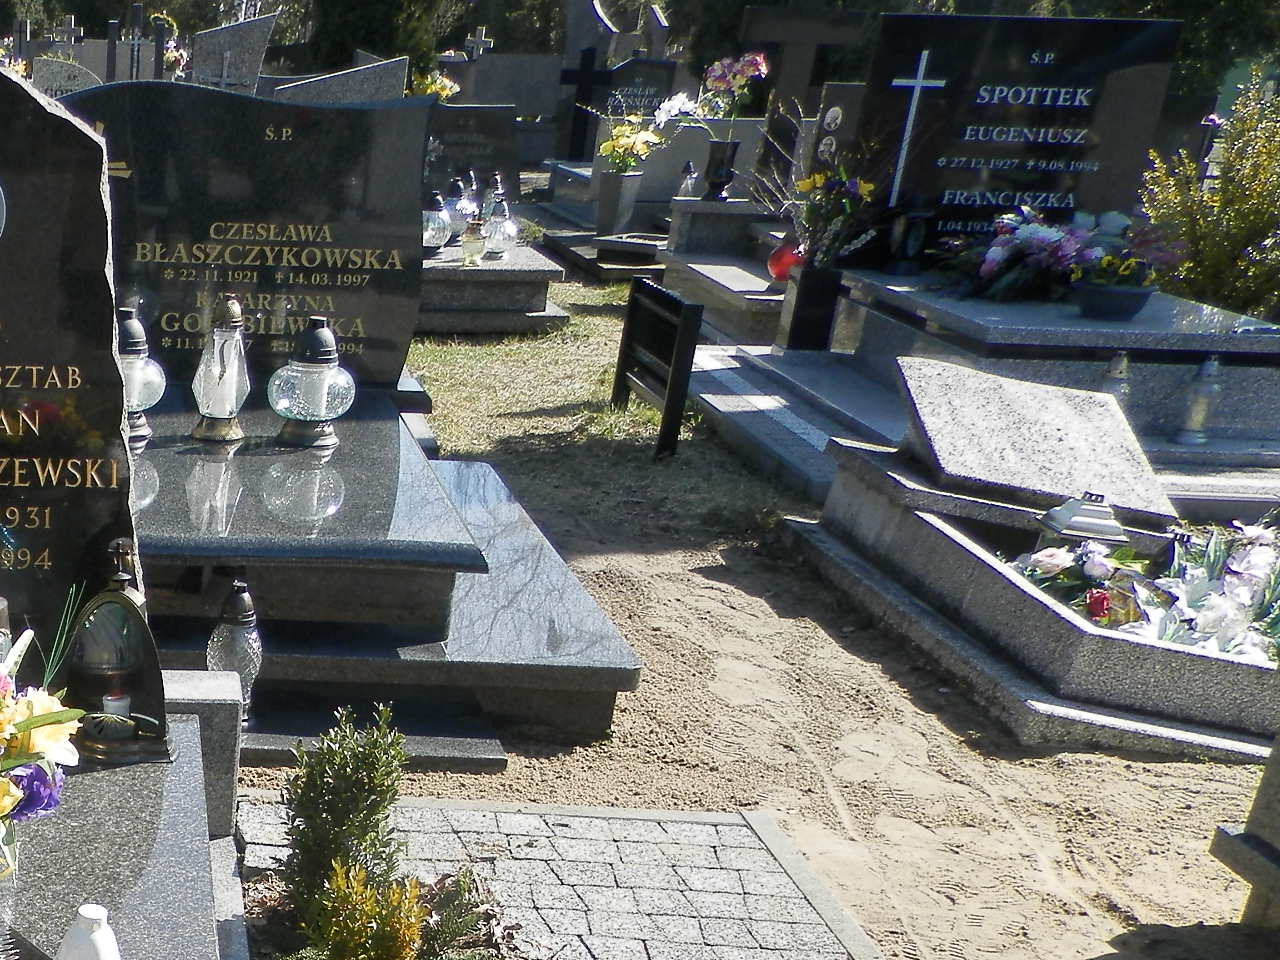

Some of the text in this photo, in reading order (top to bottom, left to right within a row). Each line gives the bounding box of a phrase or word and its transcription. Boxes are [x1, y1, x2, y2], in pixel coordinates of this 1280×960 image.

[976, 85, 1093, 107] SPOTTEK
[964, 126, 1089, 145] EUGENIUSZ
[942, 189, 1075, 208] FRANCISZKA
[209, 222, 333, 242] CZESŁAWA
[135, 242, 403, 270] BŁASZCZYKOWSKA
[196, 291, 336, 312] KAARZYNA
[161, 312, 368, 338] GOBIEWKA
